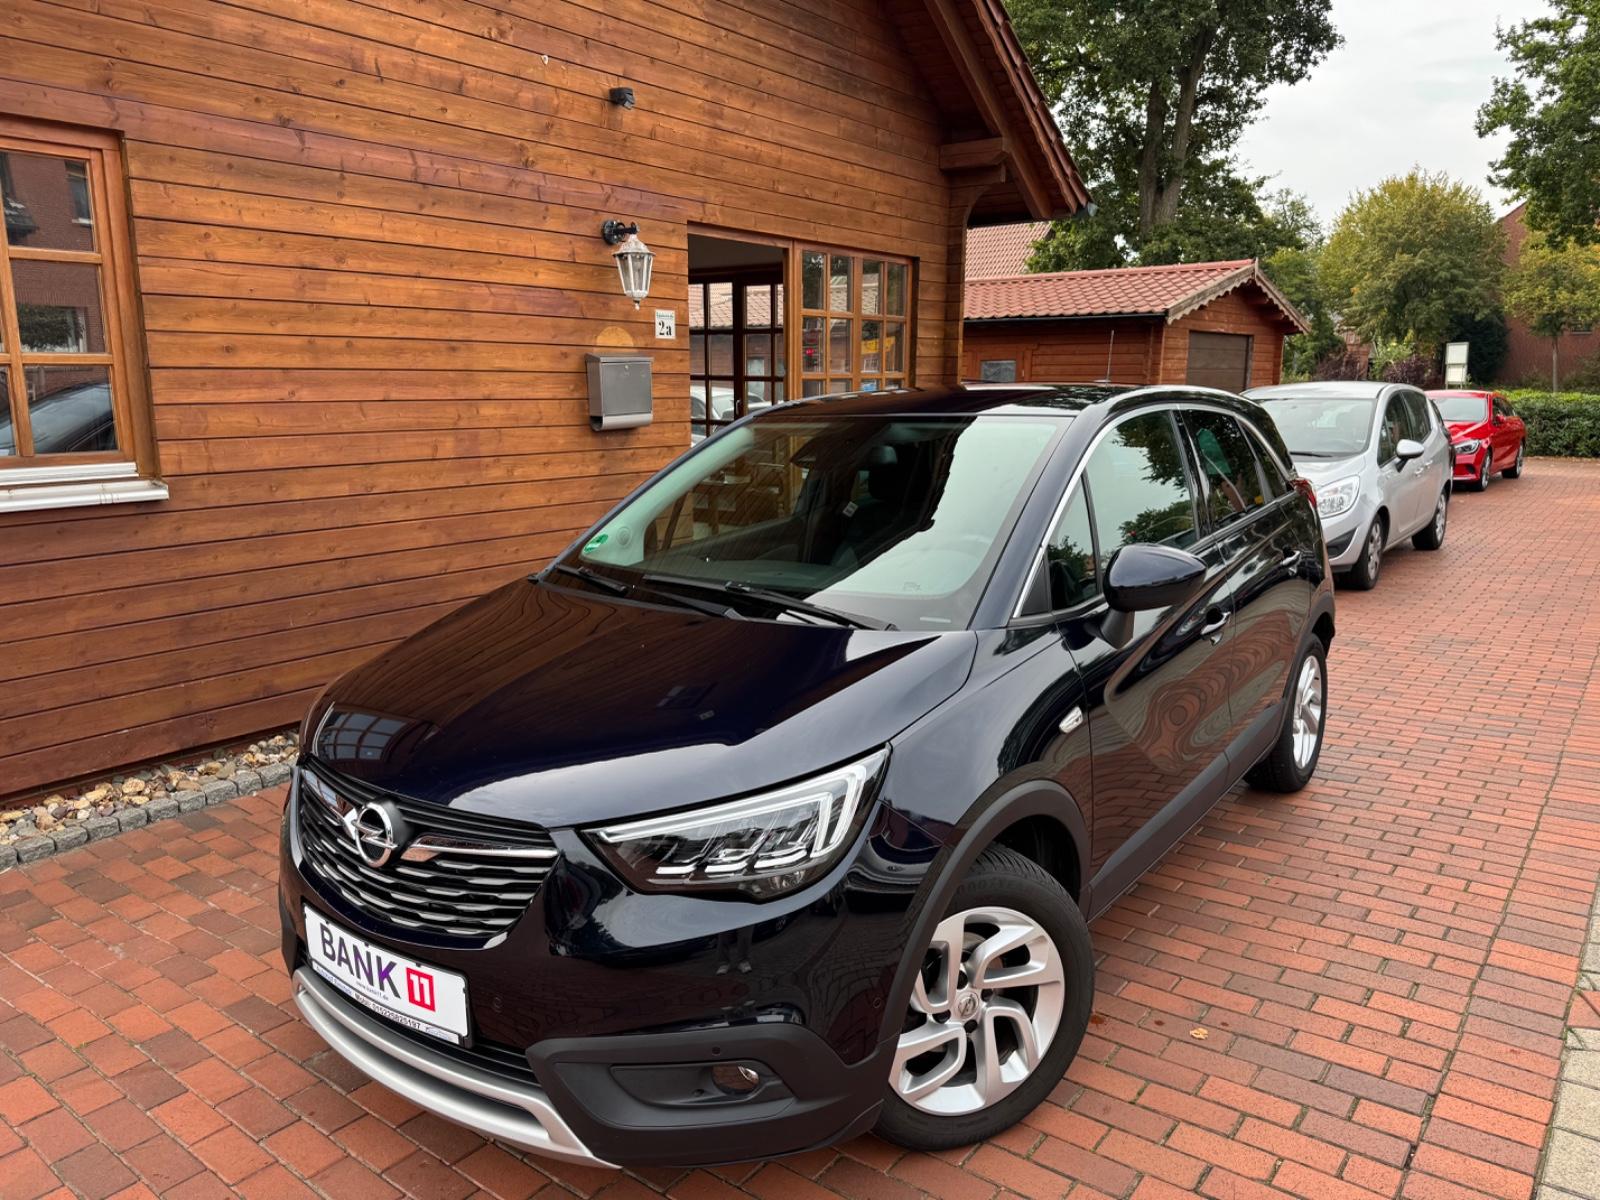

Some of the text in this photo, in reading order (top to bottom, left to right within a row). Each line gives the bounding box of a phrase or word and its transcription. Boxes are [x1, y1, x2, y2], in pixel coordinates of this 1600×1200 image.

[658, 320, 672, 336] 2a
[319, 922, 402, 999] BANK
[409, 973, 432, 1007] 11
